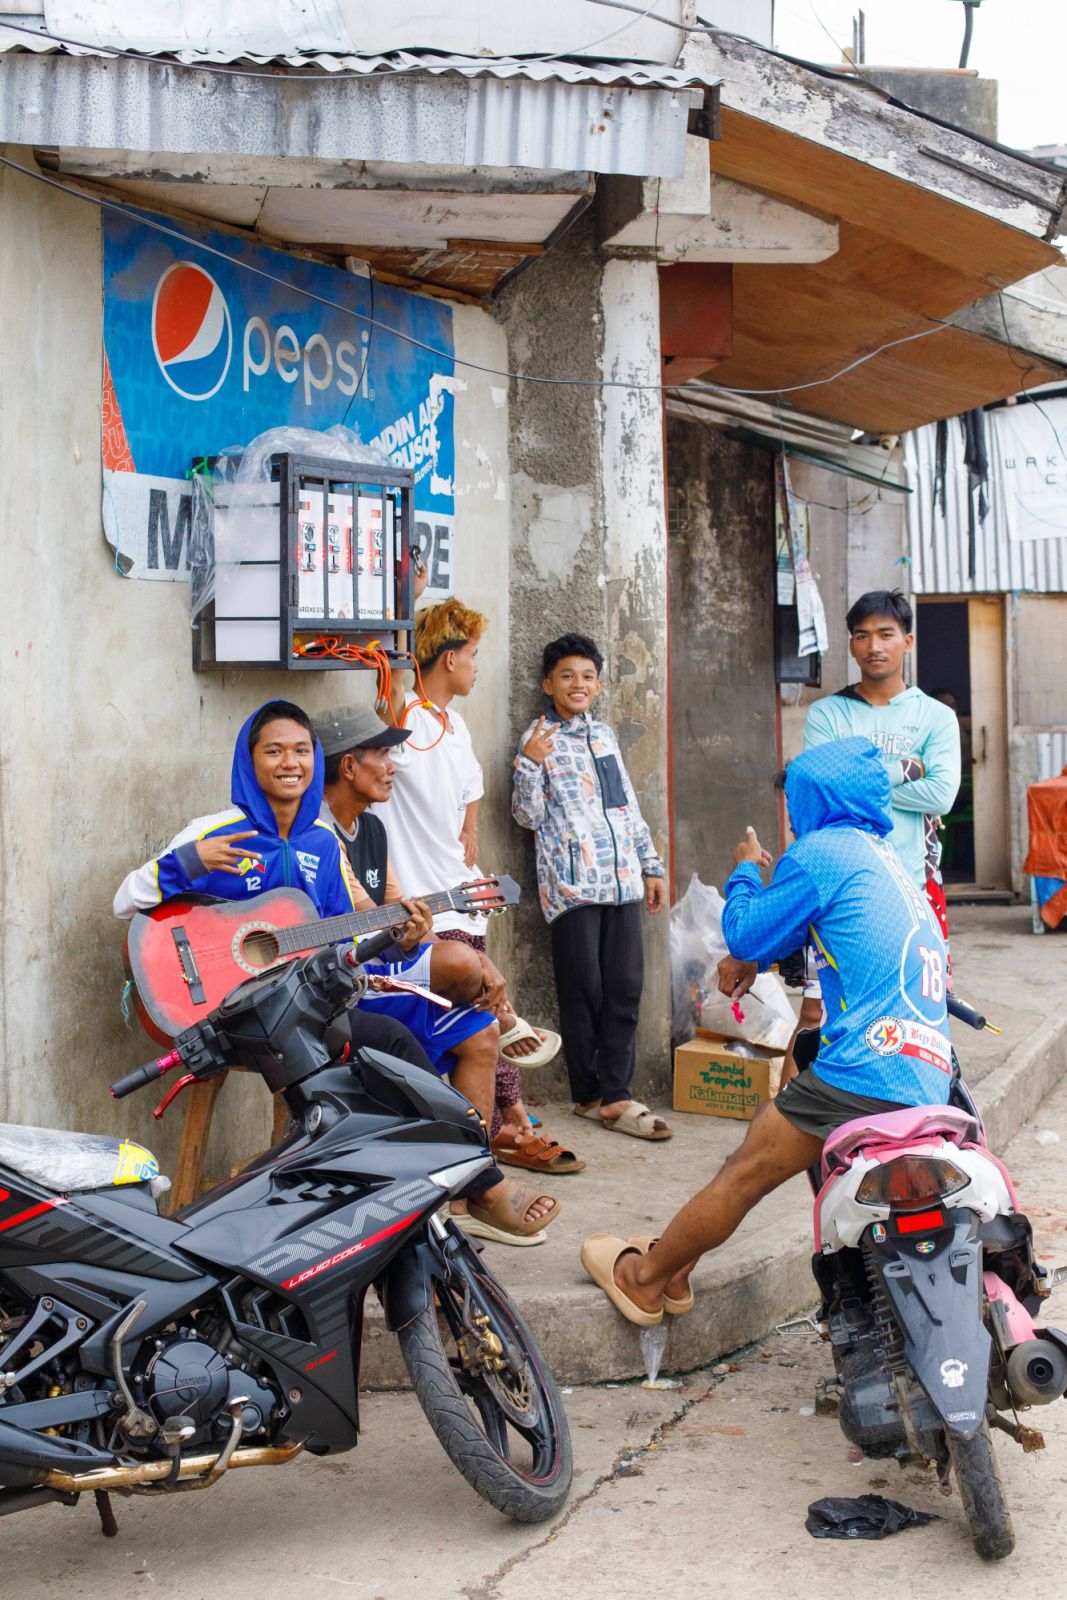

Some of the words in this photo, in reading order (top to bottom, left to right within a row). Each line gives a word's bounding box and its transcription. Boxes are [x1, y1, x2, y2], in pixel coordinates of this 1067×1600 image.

[243, 316, 369, 406] pepsi
[245, 876, 262, 892] 12
[917, 944, 944, 1005] 18
[689, 1084, 761, 1107] Kalamansi
[288, 1260, 331, 1289] LIQUID
[331, 1242, 367, 1265] COOL
